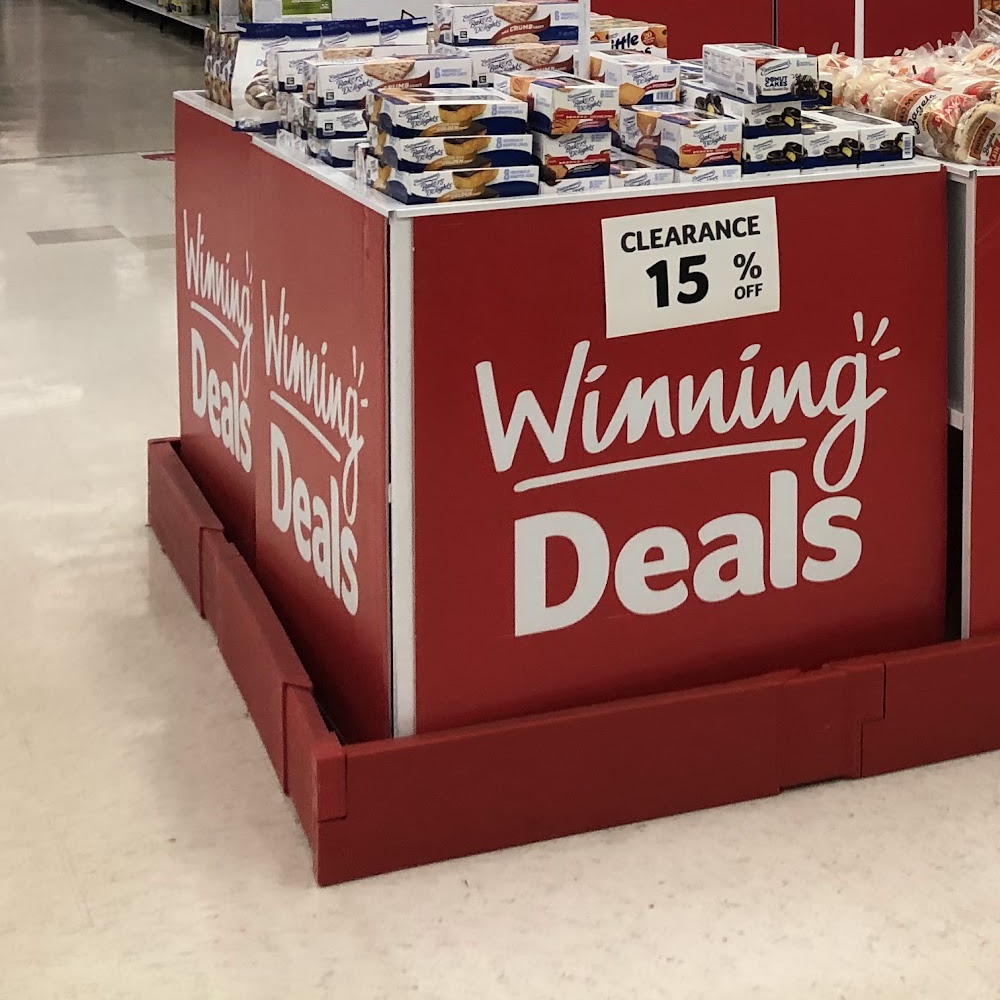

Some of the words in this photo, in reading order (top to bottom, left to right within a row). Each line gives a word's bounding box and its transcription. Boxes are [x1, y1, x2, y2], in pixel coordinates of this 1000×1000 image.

[509, 23, 533, 32] CRUMB
[908, 94, 937, 135] Bagels
[183, 209, 253, 398] Winning
[620, 214, 760, 254] CLEARANCE
[646, 254, 709, 308] 15
[733, 251, 763, 280] %
[734, 282, 763, 300] OFF
[190, 328, 252, 472] Deals
[261, 279, 364, 524] Winning
[475, 339, 888, 493] Winning
[270, 421, 358, 615] Deals
[514, 469, 862, 636] Deals
